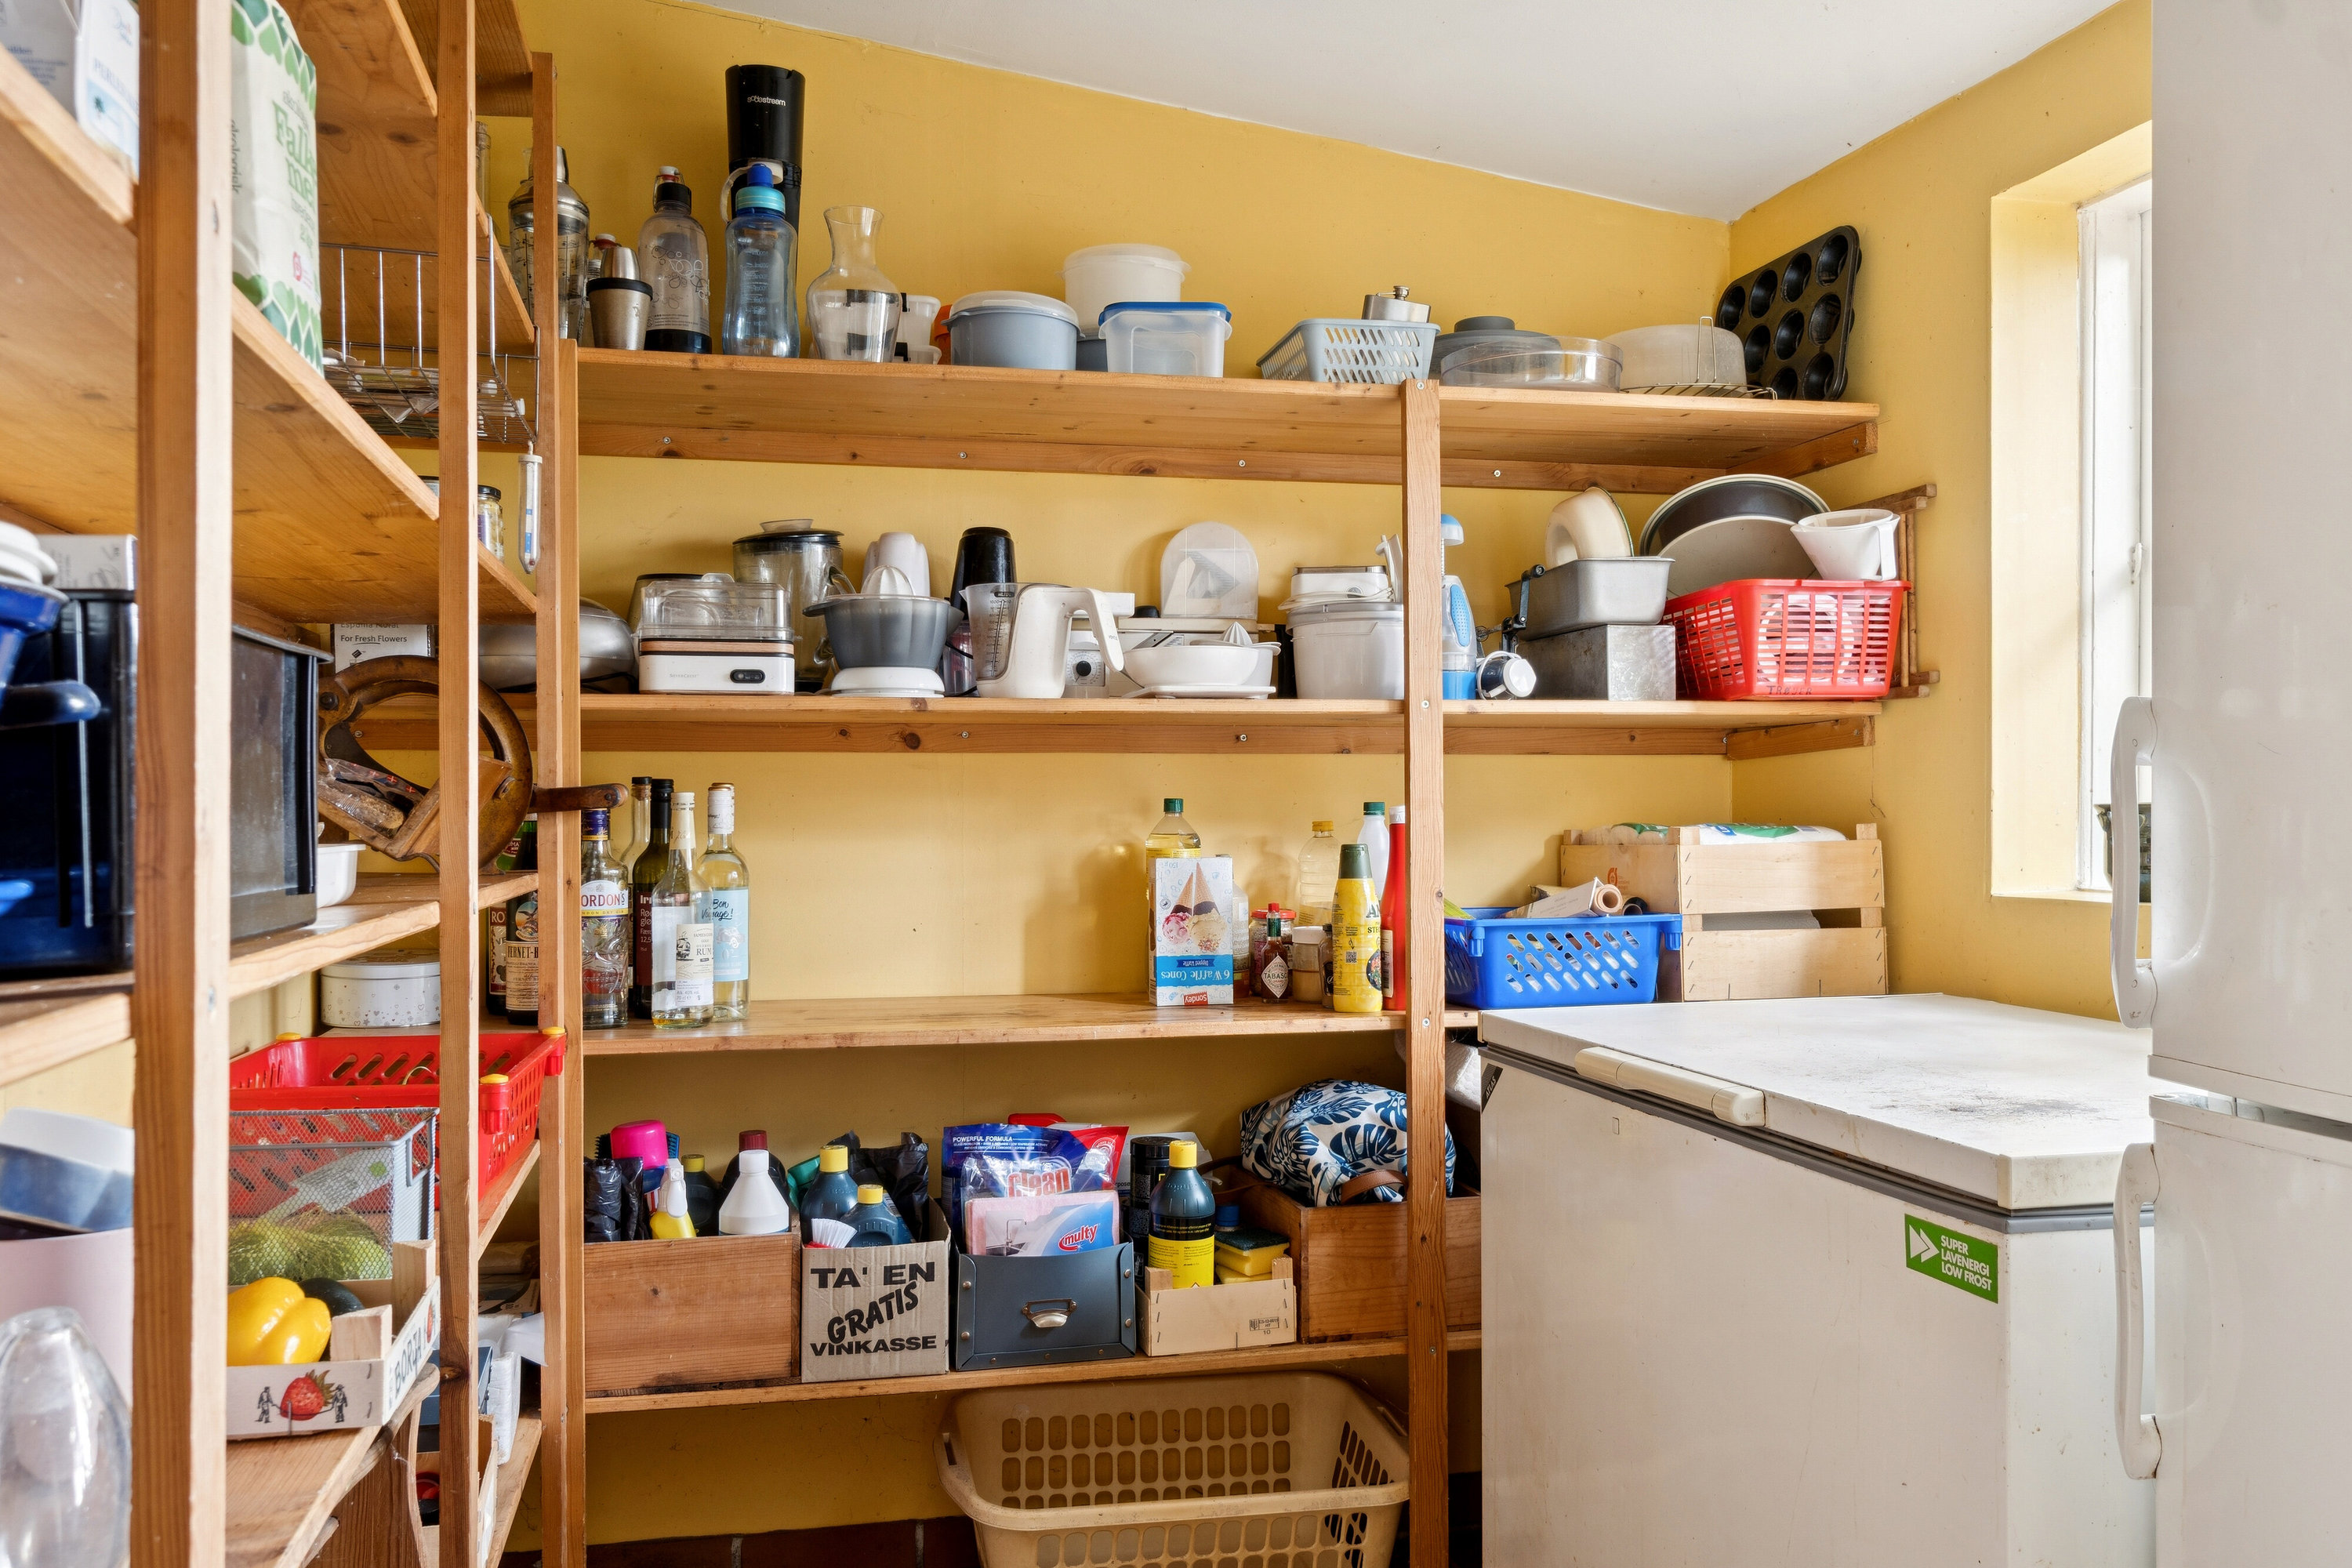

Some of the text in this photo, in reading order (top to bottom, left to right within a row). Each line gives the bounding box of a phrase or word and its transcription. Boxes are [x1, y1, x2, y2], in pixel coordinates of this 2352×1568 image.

[581, 891, 626, 907] ORDON'S
[713, 898, 729, 910] Bon
[1160, 969, 1230, 981] 6 Waffle Cones
[1185, 994, 1207, 1004] Sondey
[1485, 1075, 1497, 1099] ATLAS
[1064, 1224, 1098, 1243] multy
[1940, 1235, 1969, 1255] SUPER
[1941, 1248, 1989, 1276] LAVENERGI
[810, 1261, 935, 1288] TA' EN
[1941, 1261, 1992, 1290] LOW FROST
[827, 1281, 919, 1345] GRATIS
[810, 1335, 937, 1356] VINKASSE
